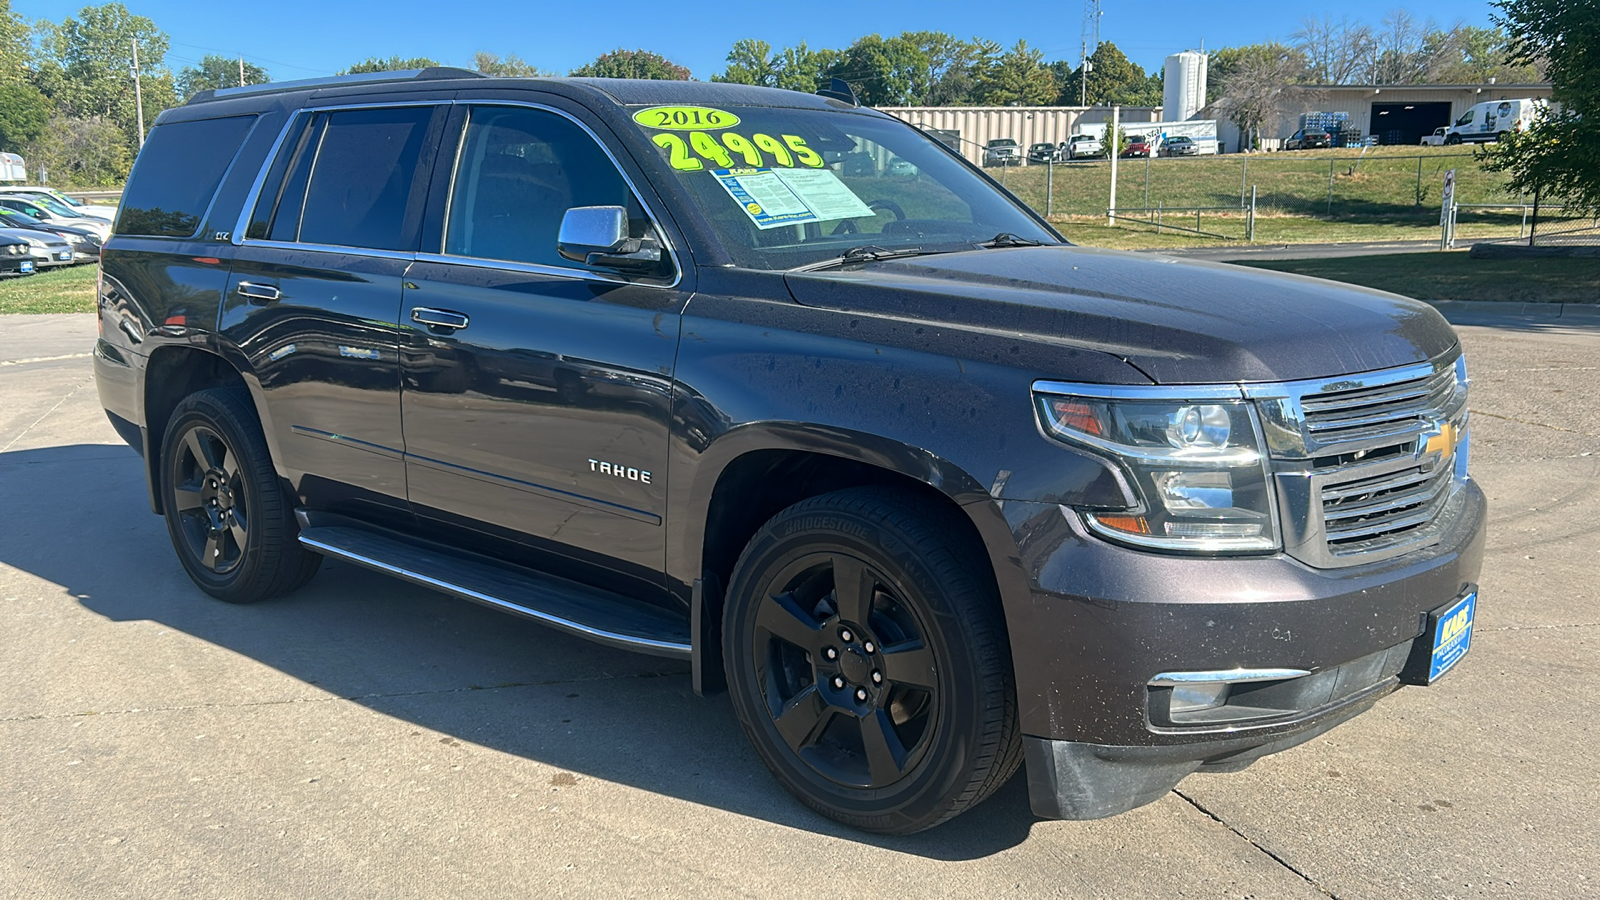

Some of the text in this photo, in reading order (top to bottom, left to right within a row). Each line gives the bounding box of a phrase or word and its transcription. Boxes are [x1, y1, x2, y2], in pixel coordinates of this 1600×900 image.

[655, 109, 722, 127] 2016
[651, 131, 825, 172] 24995
[588, 458, 652, 484] TAHOE
[784, 516, 872, 540] BRIDGESTONE
[1440, 604, 1470, 644] KARS
